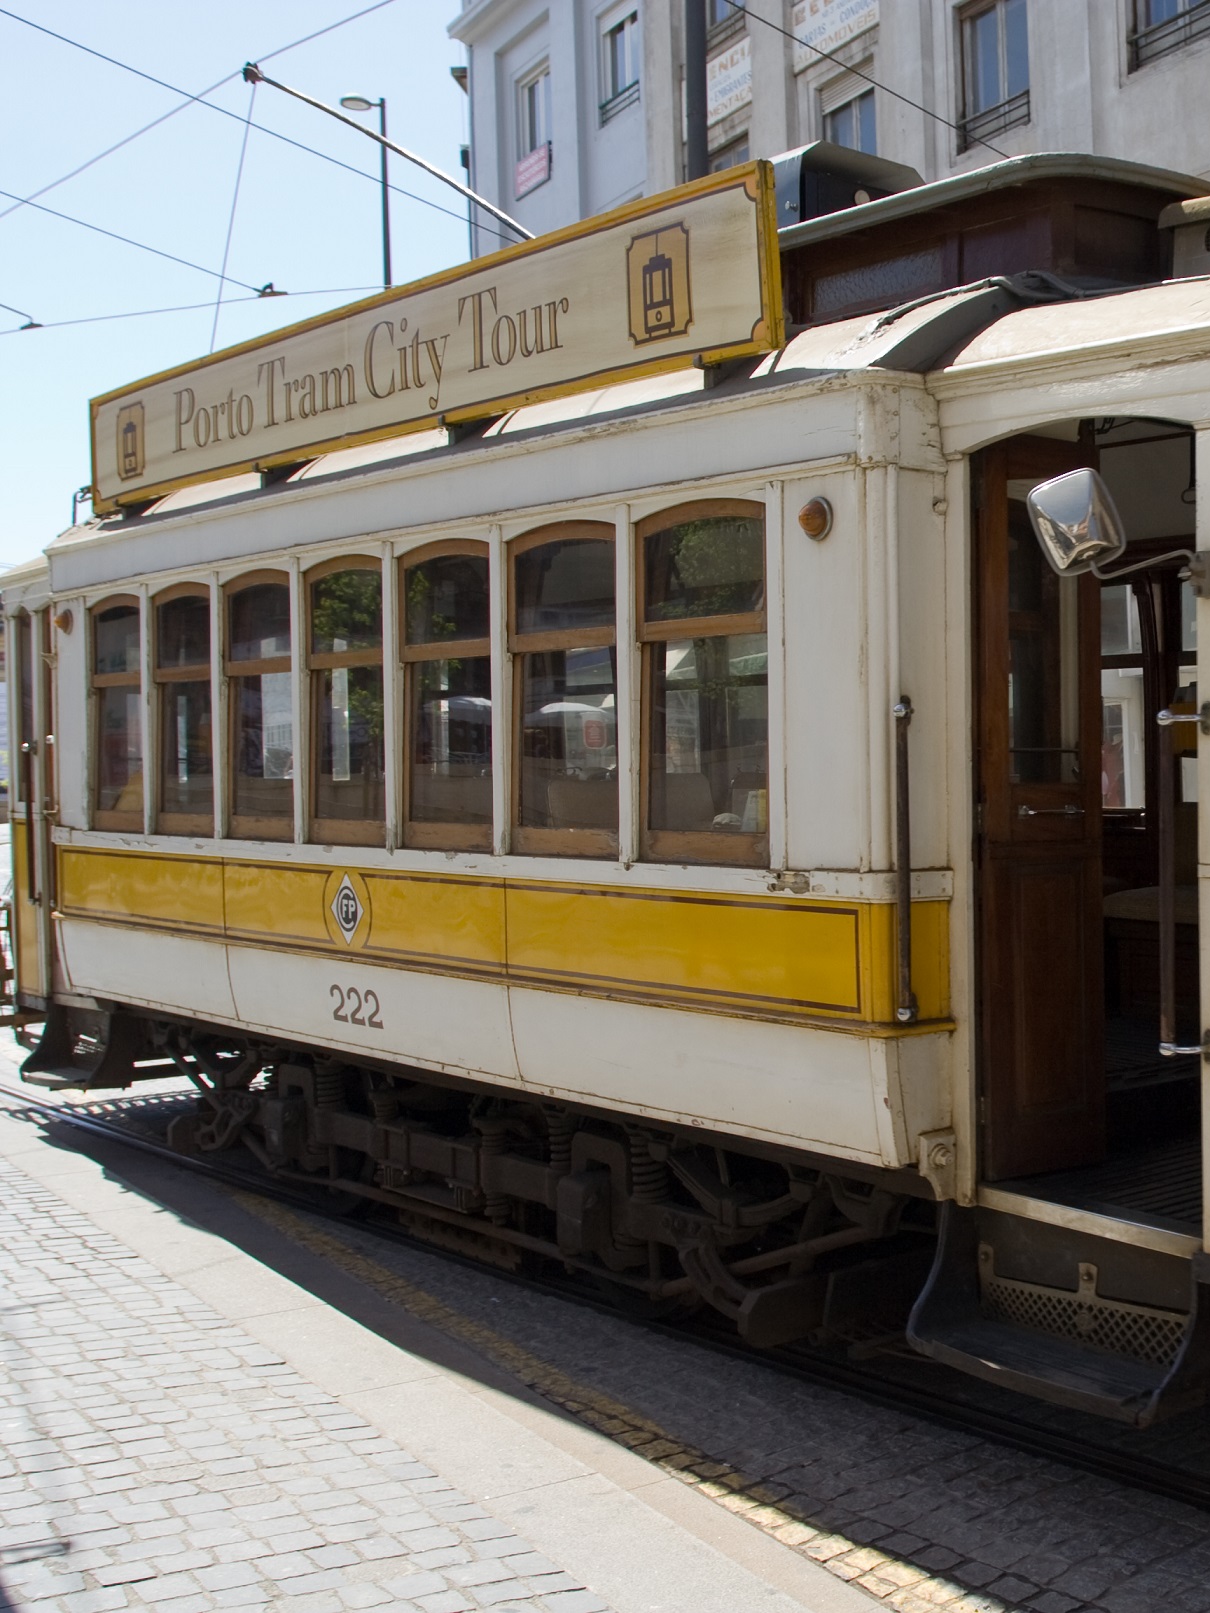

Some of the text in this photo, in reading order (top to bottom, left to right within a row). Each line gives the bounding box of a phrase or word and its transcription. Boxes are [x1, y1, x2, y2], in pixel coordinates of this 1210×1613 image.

[172, 286, 570, 454] Porto Tram City Tour
[330, 984, 384, 1029] 222
